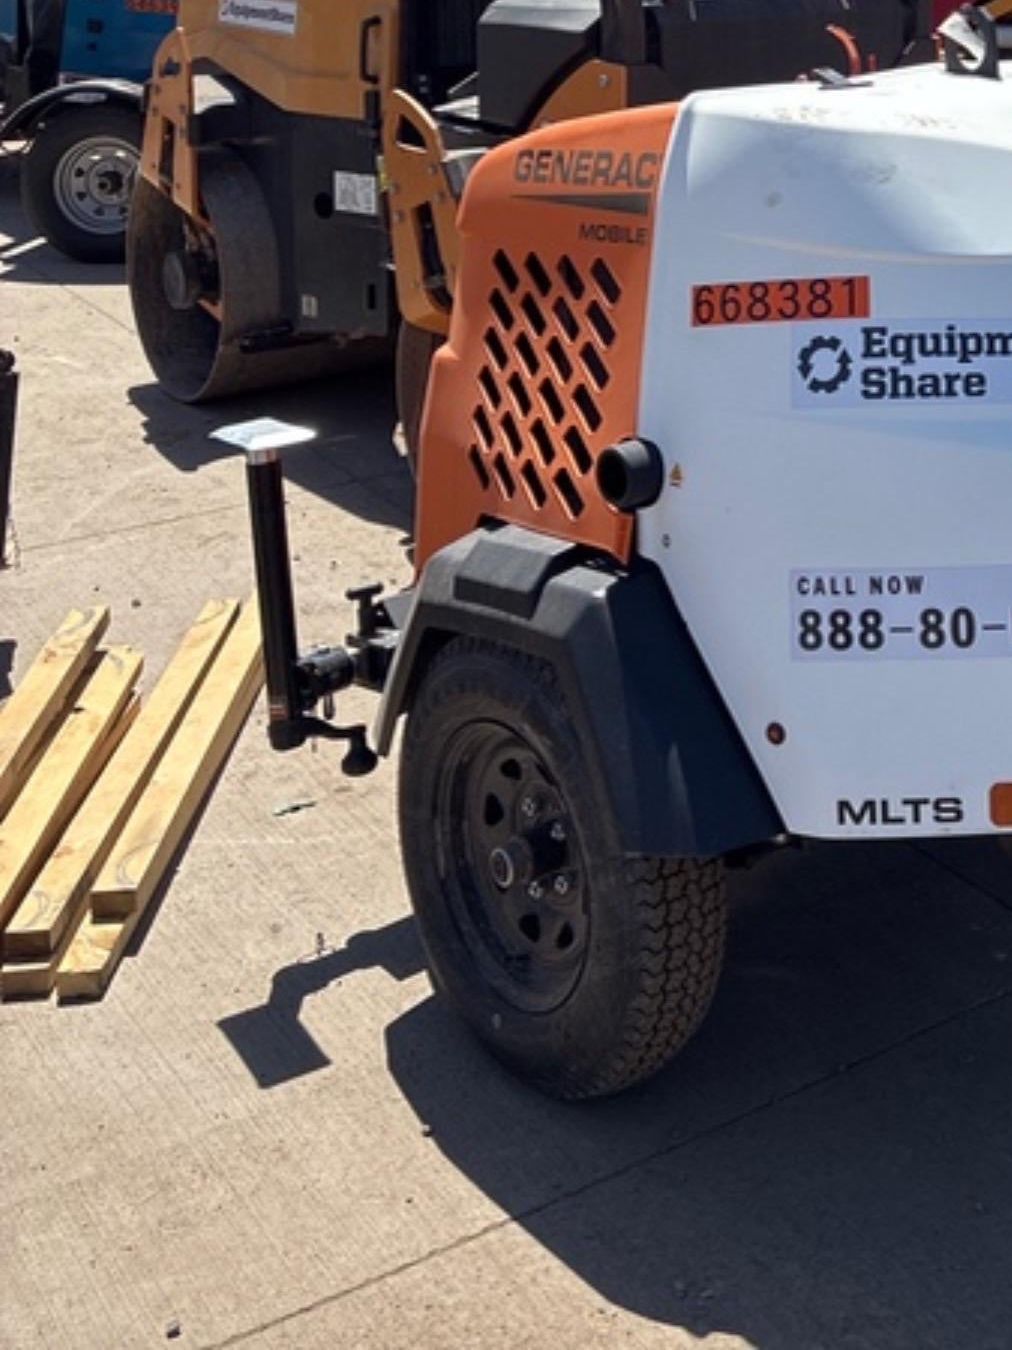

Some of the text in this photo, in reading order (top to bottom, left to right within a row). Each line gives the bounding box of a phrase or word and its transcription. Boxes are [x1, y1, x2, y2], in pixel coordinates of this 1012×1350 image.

[515, 149, 659, 187] GENERAC
[578, 223, 647, 245] MOBILE
[694, 276, 858, 324] 668381
[860, 366, 988, 399] Share
[797, 575, 925, 596] CALL NOW
[836, 796, 965, 826] MLTS
